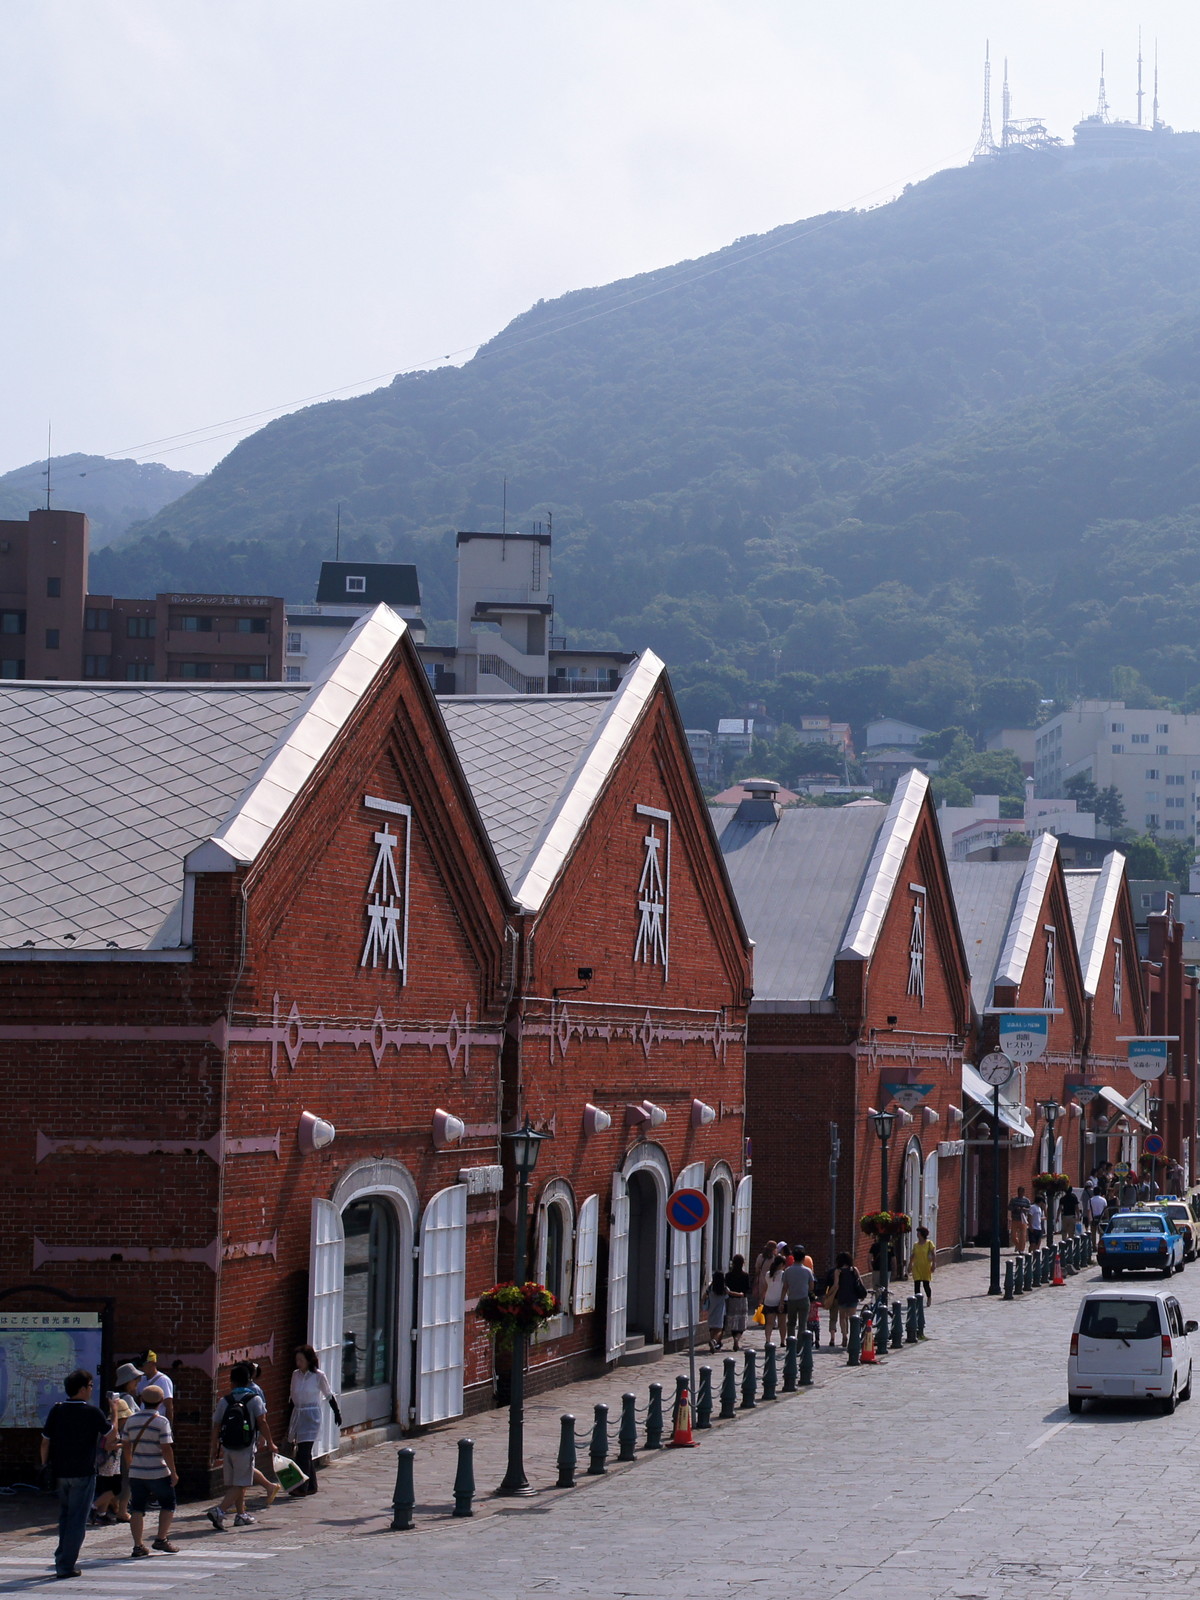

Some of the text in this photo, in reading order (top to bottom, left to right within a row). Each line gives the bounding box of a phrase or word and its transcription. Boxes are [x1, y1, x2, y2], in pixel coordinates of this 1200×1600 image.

[1, 1316, 81, 1325] はこだて観光案内
